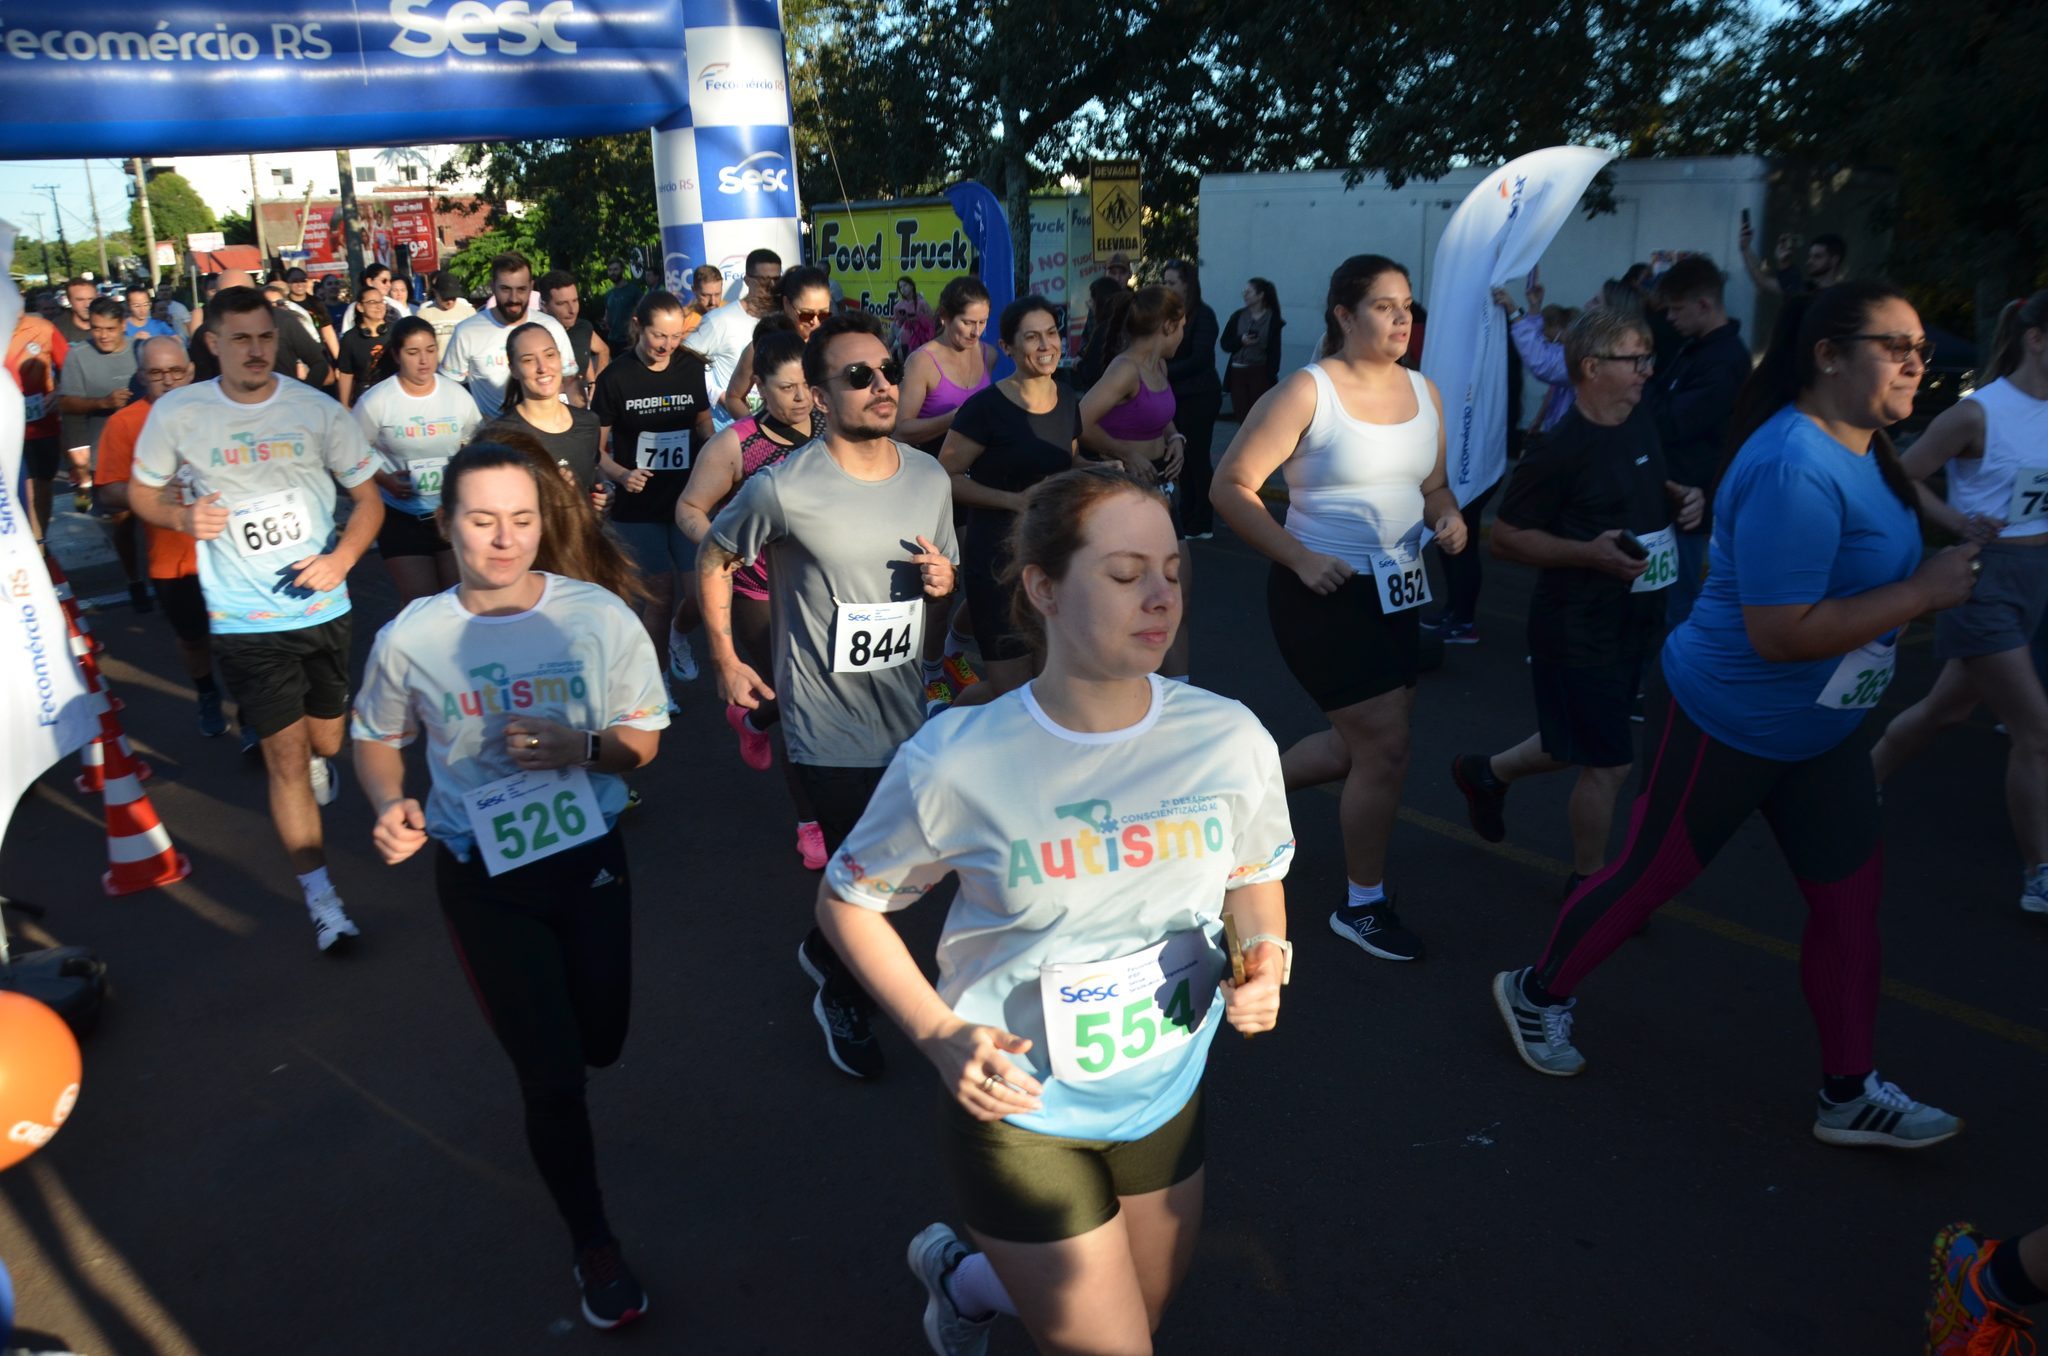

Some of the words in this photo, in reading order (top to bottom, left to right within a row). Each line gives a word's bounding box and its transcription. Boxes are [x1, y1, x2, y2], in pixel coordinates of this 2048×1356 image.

[271, 23, 333, 60] RS
[389, 0, 578, 58] Sesc
[679, 179, 694, 191] RS
[718, 166, 789, 195] Sesc
[1094, 165, 1137, 177] DEVAGAR
[820, 221, 882, 273] Food
[895, 217, 968, 272] Truck
[1097, 237, 1138, 251] ELEVADA
[1038, 252, 1066, 271] NO
[394, 422, 459, 439] Autismo
[210, 442, 305, 467] Autismo
[645, 446, 684, 468] 716
[1459, 406, 1474, 486] Fecomércio
[416, 470, 442, 492] 42
[11, 567, 32, 598] RS
[1387, 567, 1426, 607] 852
[848, 613, 872, 622] Sesc
[849, 622, 912, 667] 844
[20, 604, 58, 728] Fecomércio
[443, 675, 587, 724] Autismo
[492, 790, 587, 860] 526
[1120, 802, 1208, 824] CONSCIENTIZAÇÃO
[1007, 816, 1224, 889] Autismo
[1060, 983, 1120, 1003] Sesc
[1075, 976, 1196, 1074] 554
